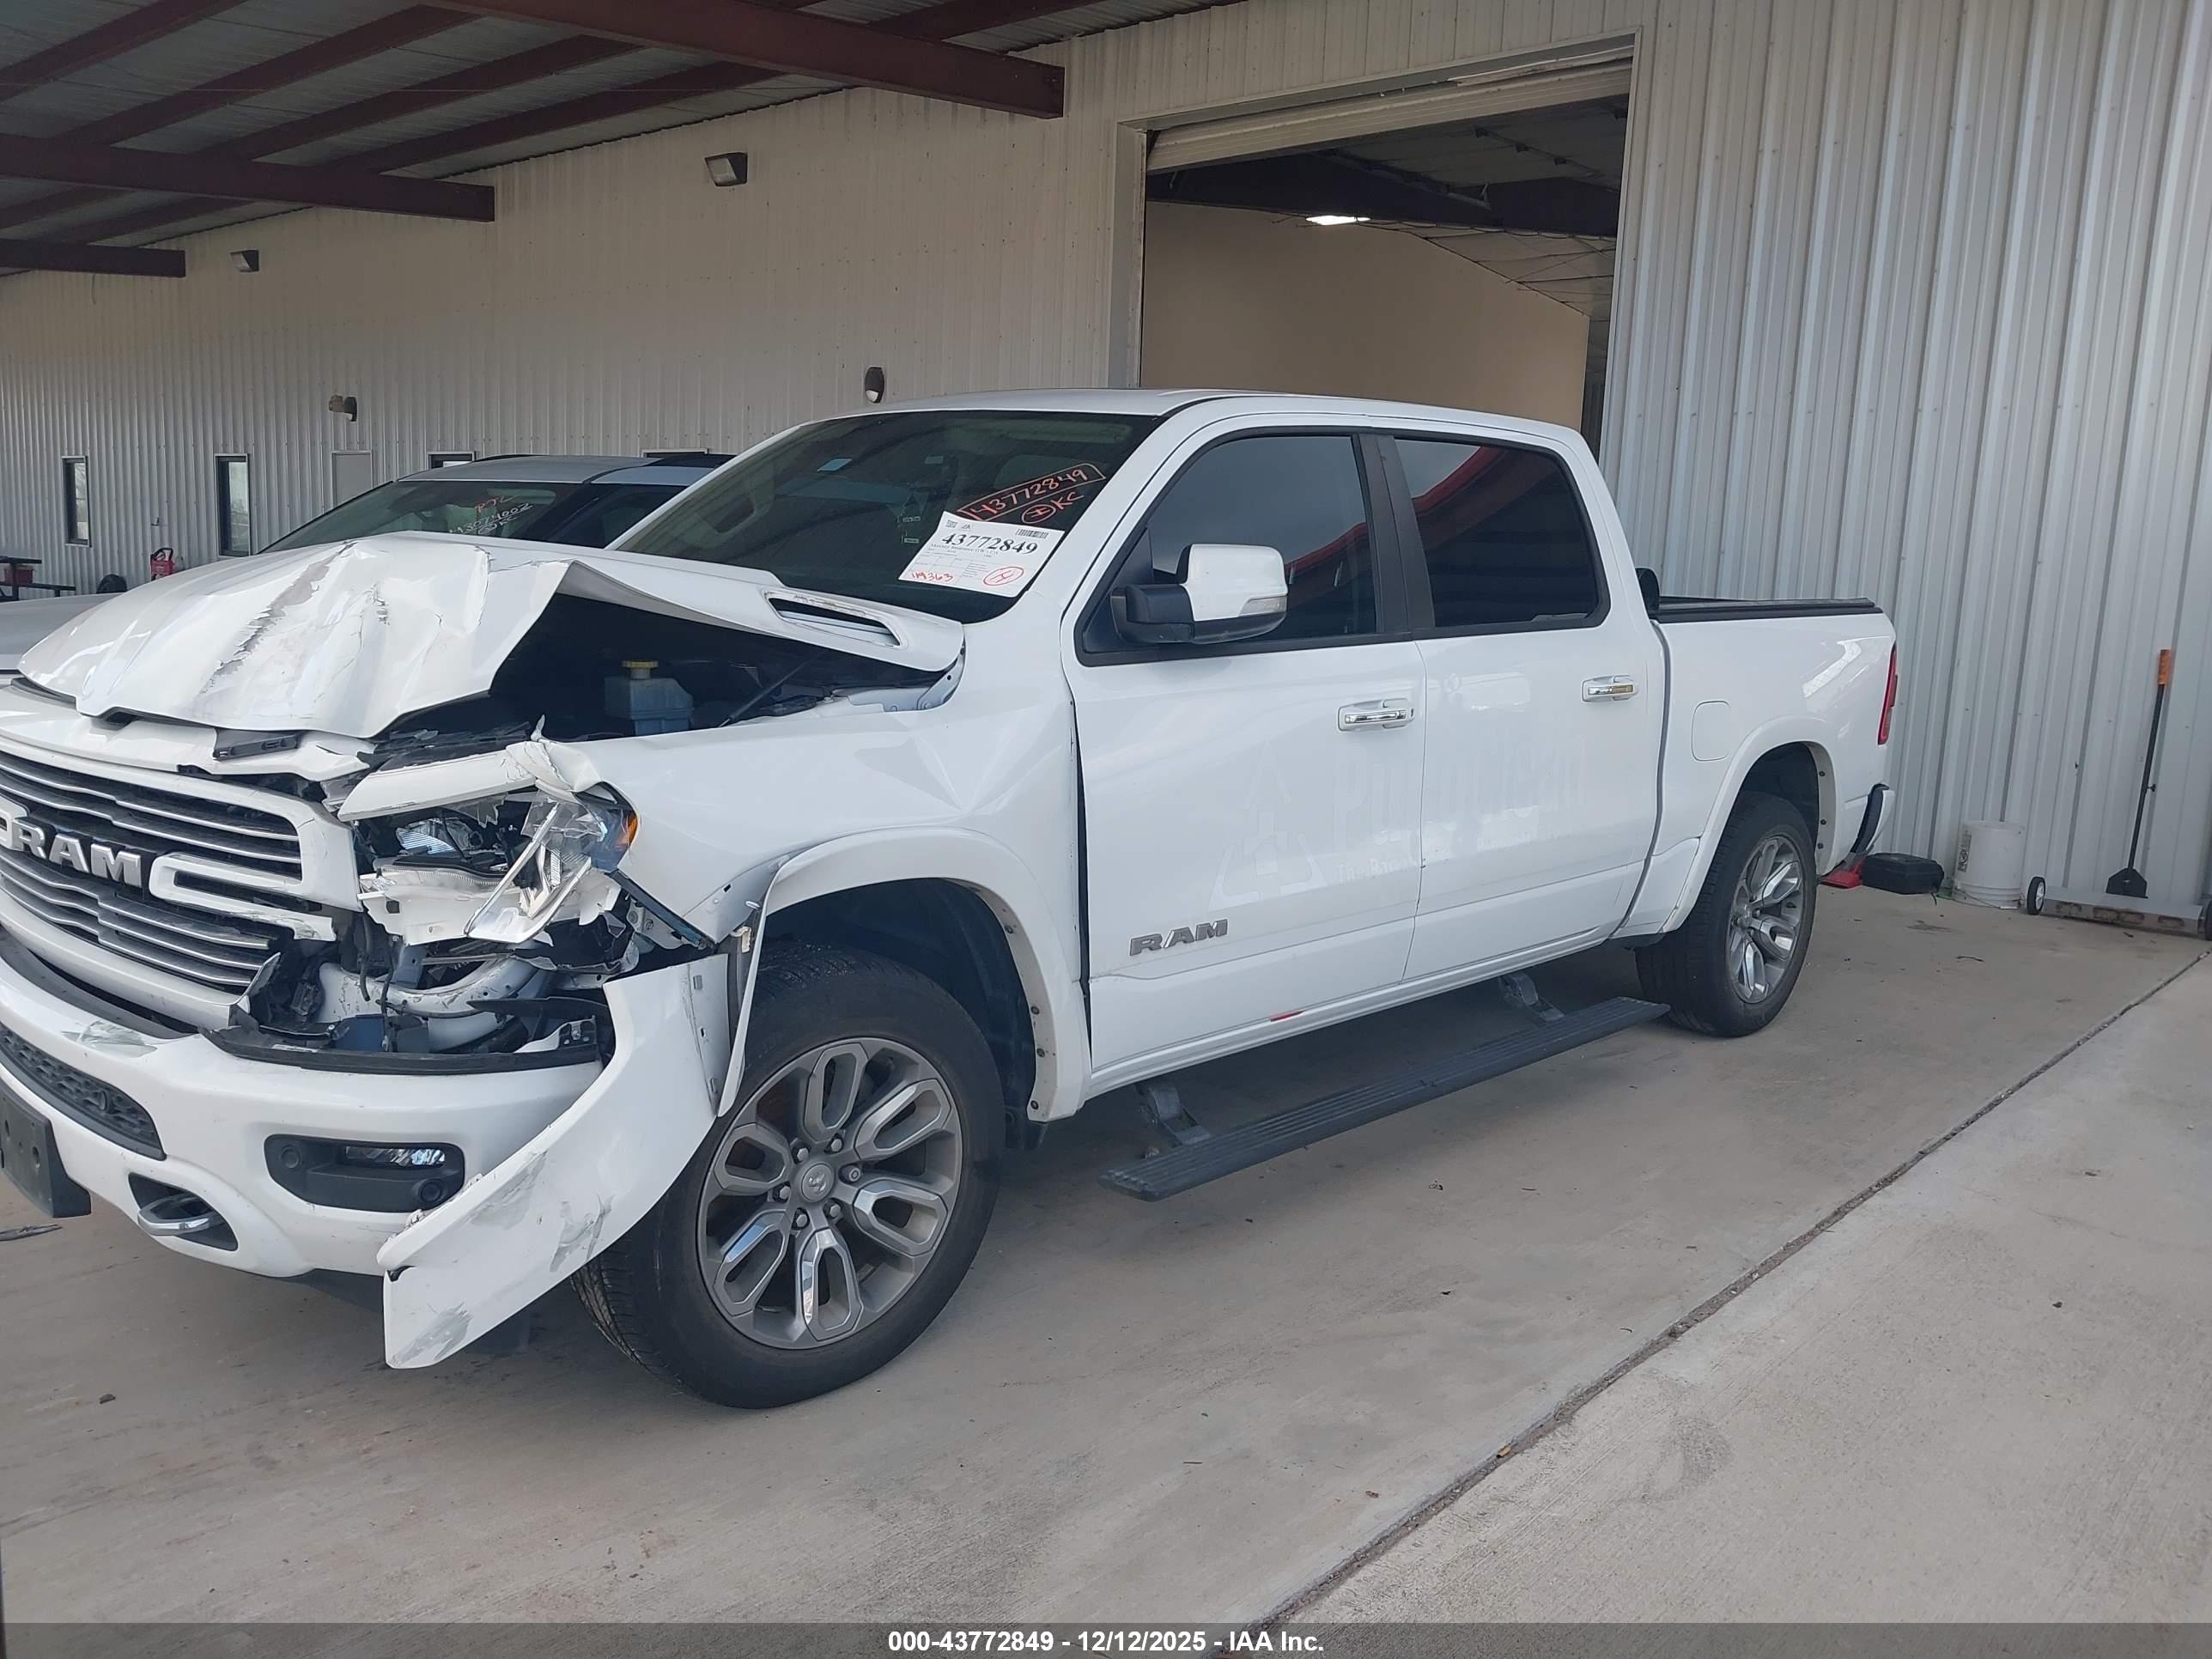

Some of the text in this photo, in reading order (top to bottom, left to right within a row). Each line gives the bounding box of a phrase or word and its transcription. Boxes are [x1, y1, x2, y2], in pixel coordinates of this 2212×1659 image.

[970, 469, 1088, 514] 43772849
[942, 533, 1038, 555] 43772849
[12, 817, 142, 888] RAM
[1129, 918, 1228, 957] RAM
